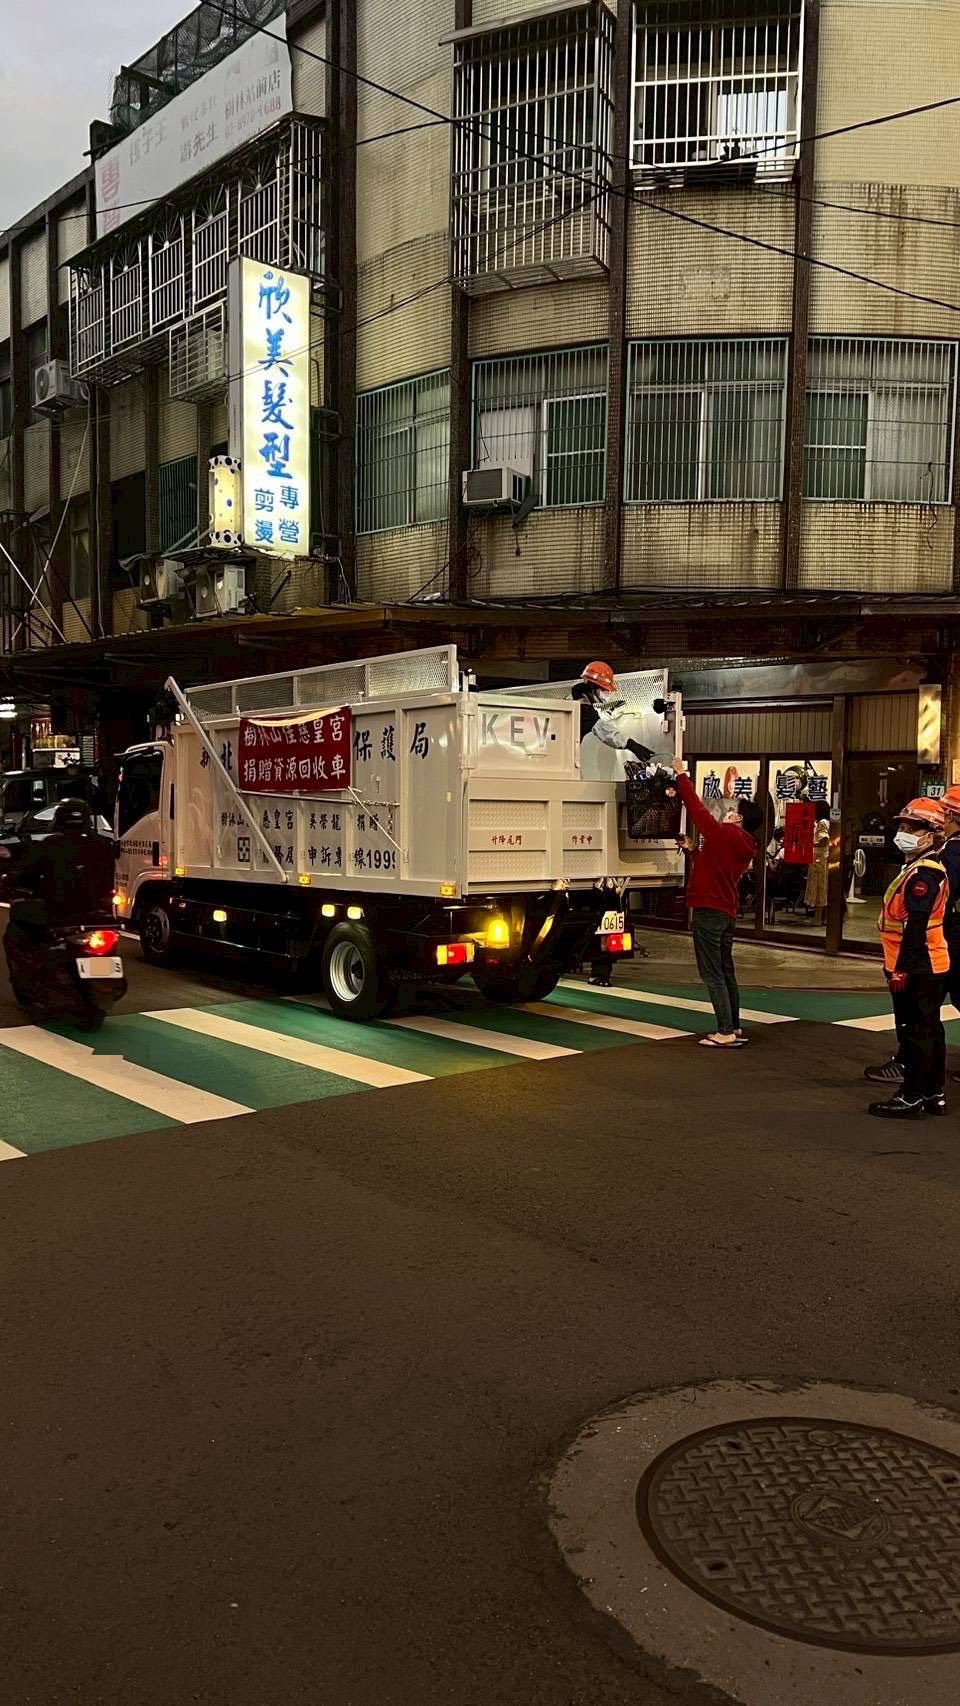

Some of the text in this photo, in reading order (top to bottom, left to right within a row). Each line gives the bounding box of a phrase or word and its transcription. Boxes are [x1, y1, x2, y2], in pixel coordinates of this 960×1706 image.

[257, 270, 294, 480] 欣美髮型
[278, 484, 300, 544] 專營
[353, 721, 432, 763] 保護局
[243, 753, 346, 783] 捐贈資源回收車
[930, 786, 941, 797] 31
[603, 916, 624, 931] 0615
